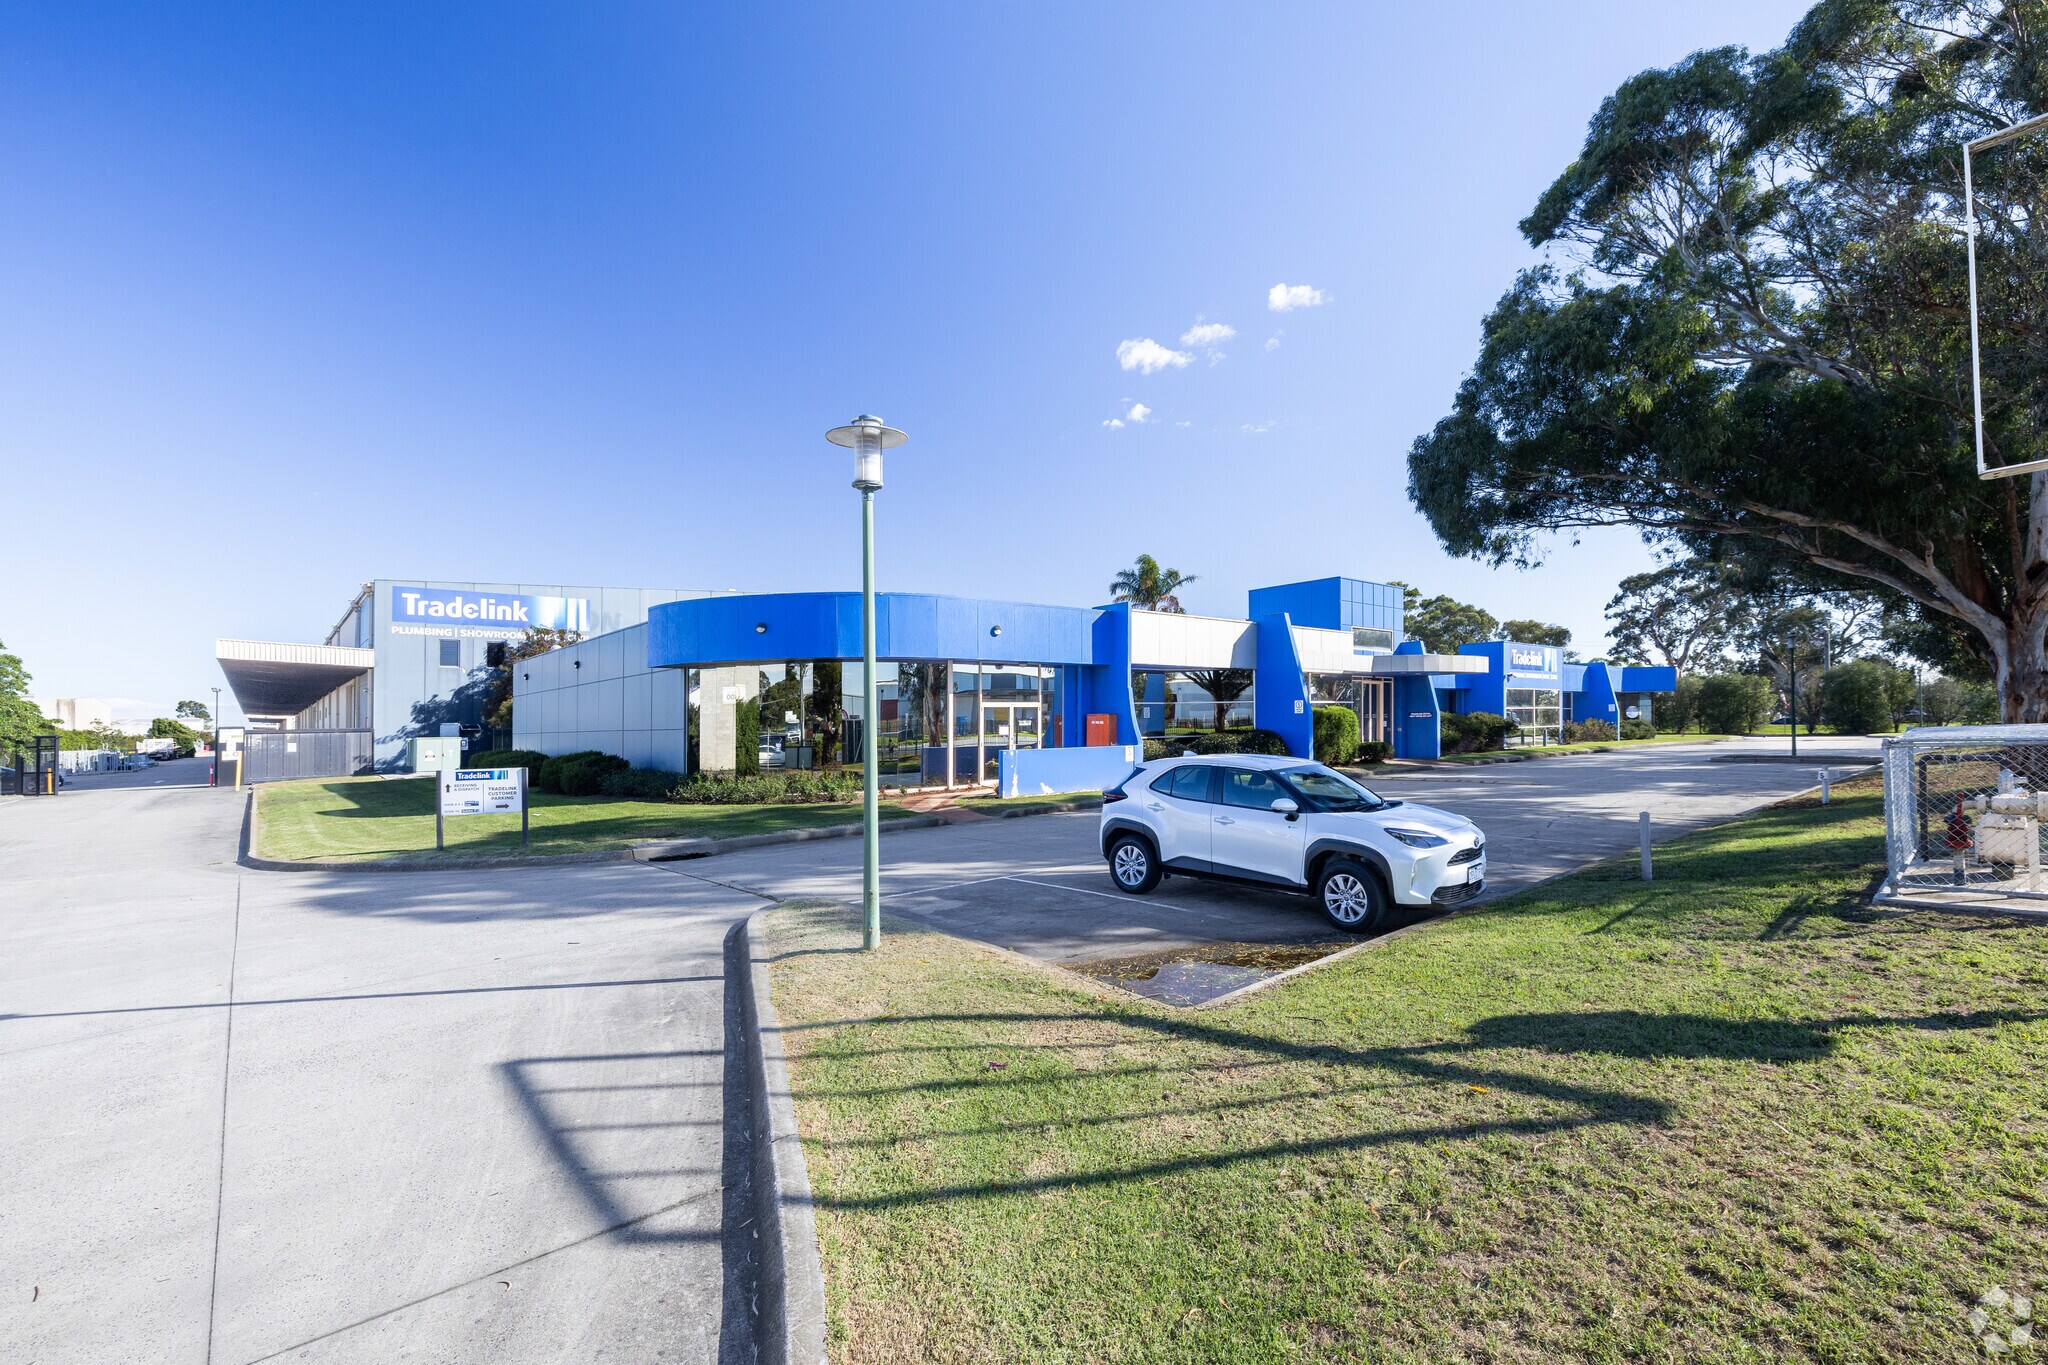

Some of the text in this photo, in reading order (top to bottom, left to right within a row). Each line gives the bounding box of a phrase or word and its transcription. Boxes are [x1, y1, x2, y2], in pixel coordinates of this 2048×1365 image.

[401, 592, 529, 622] Tradelink
[391, 626, 453, 637] PLUMBING
[460, 629, 527, 640] SHOWROOM
[1512, 649, 1542, 666] Tradelink
